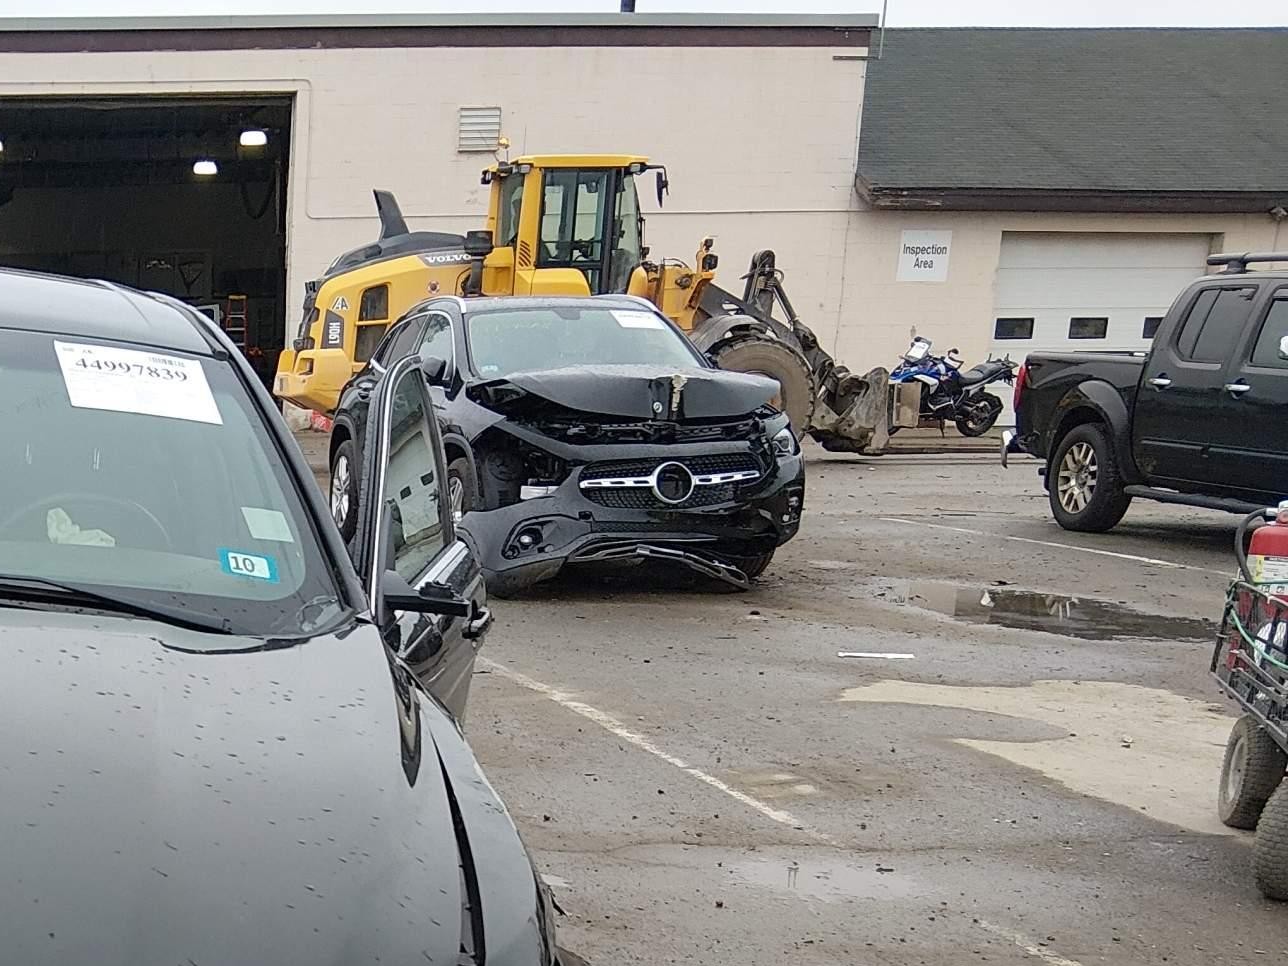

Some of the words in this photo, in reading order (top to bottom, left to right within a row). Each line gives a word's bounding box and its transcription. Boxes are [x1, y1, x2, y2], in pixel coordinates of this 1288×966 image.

[903, 244, 948, 256] Inspection
[424, 253, 472, 263] VOLVO
[913, 257, 934, 269] Area
[328, 322, 341, 344] L90H
[75, 358, 189, 382] 44997839
[230, 556, 255, 573] 10
